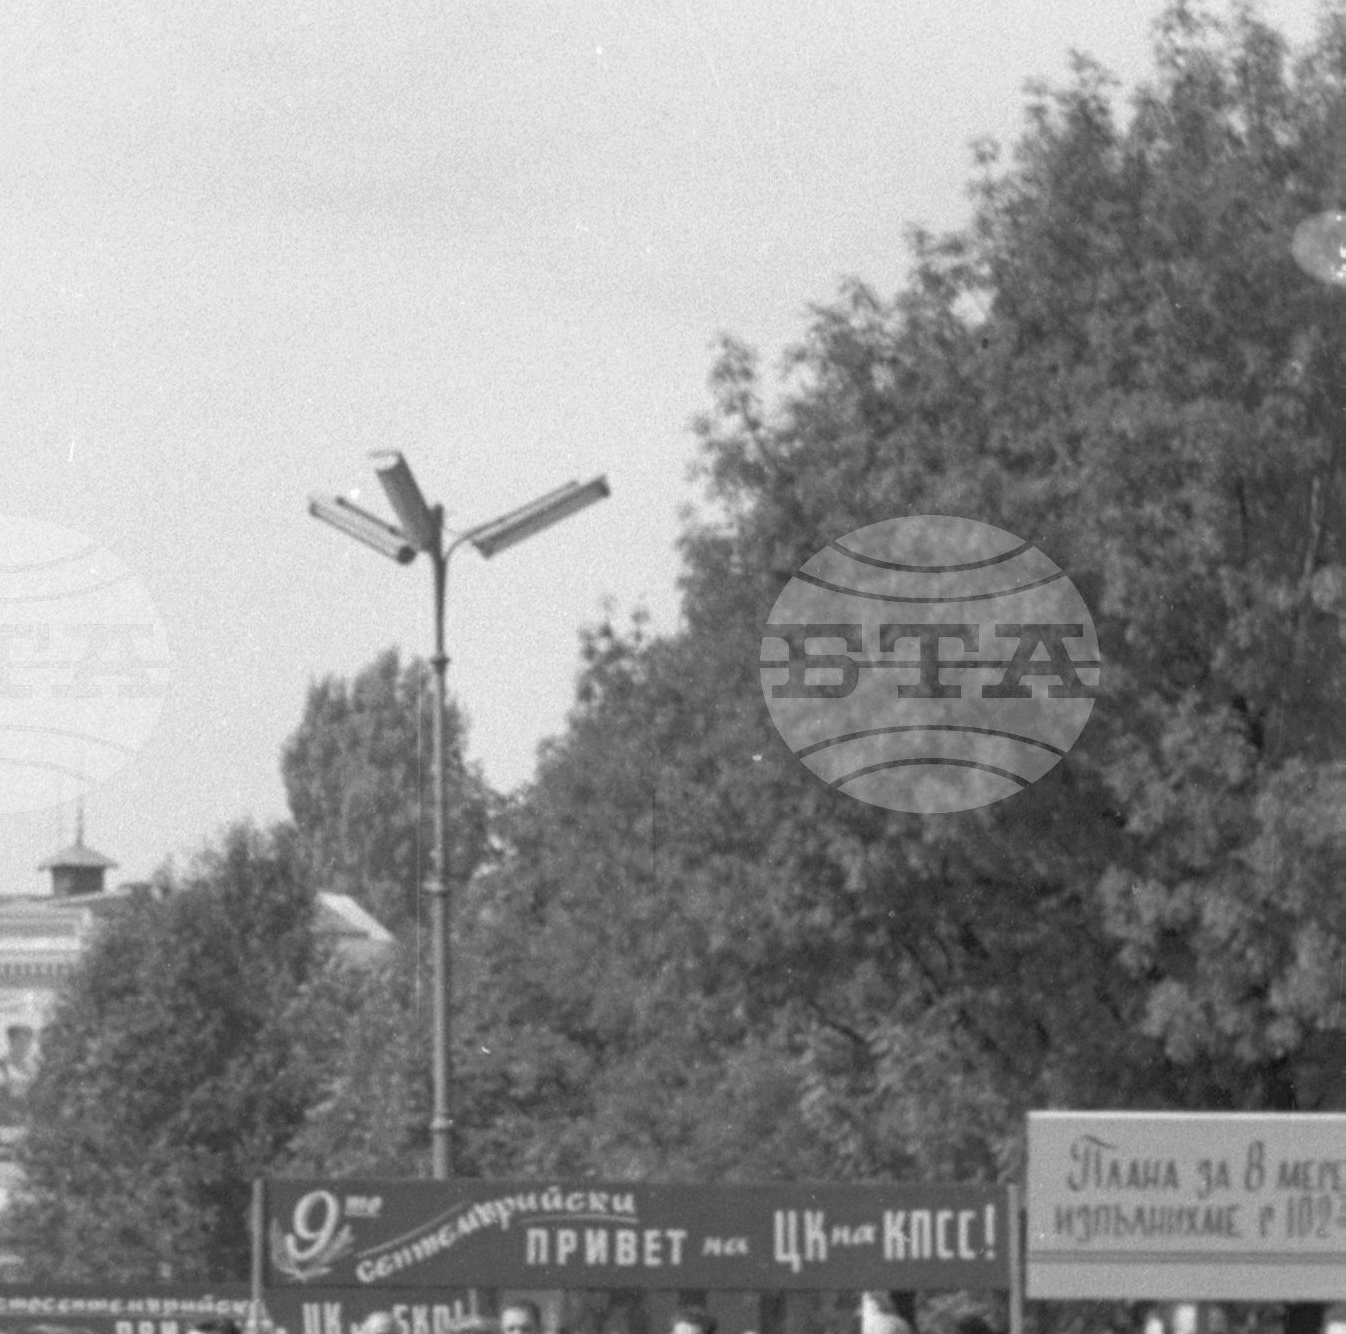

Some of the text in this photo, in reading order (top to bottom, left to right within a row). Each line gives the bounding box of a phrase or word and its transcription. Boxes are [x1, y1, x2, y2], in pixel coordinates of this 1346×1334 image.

[1244, 1140, 1267, 1192] 8
[356, 1185, 636, 1283] септемврийски
[526, 1204, 996, 1273] ПРИВЕТ на ЦК на КПСС!
